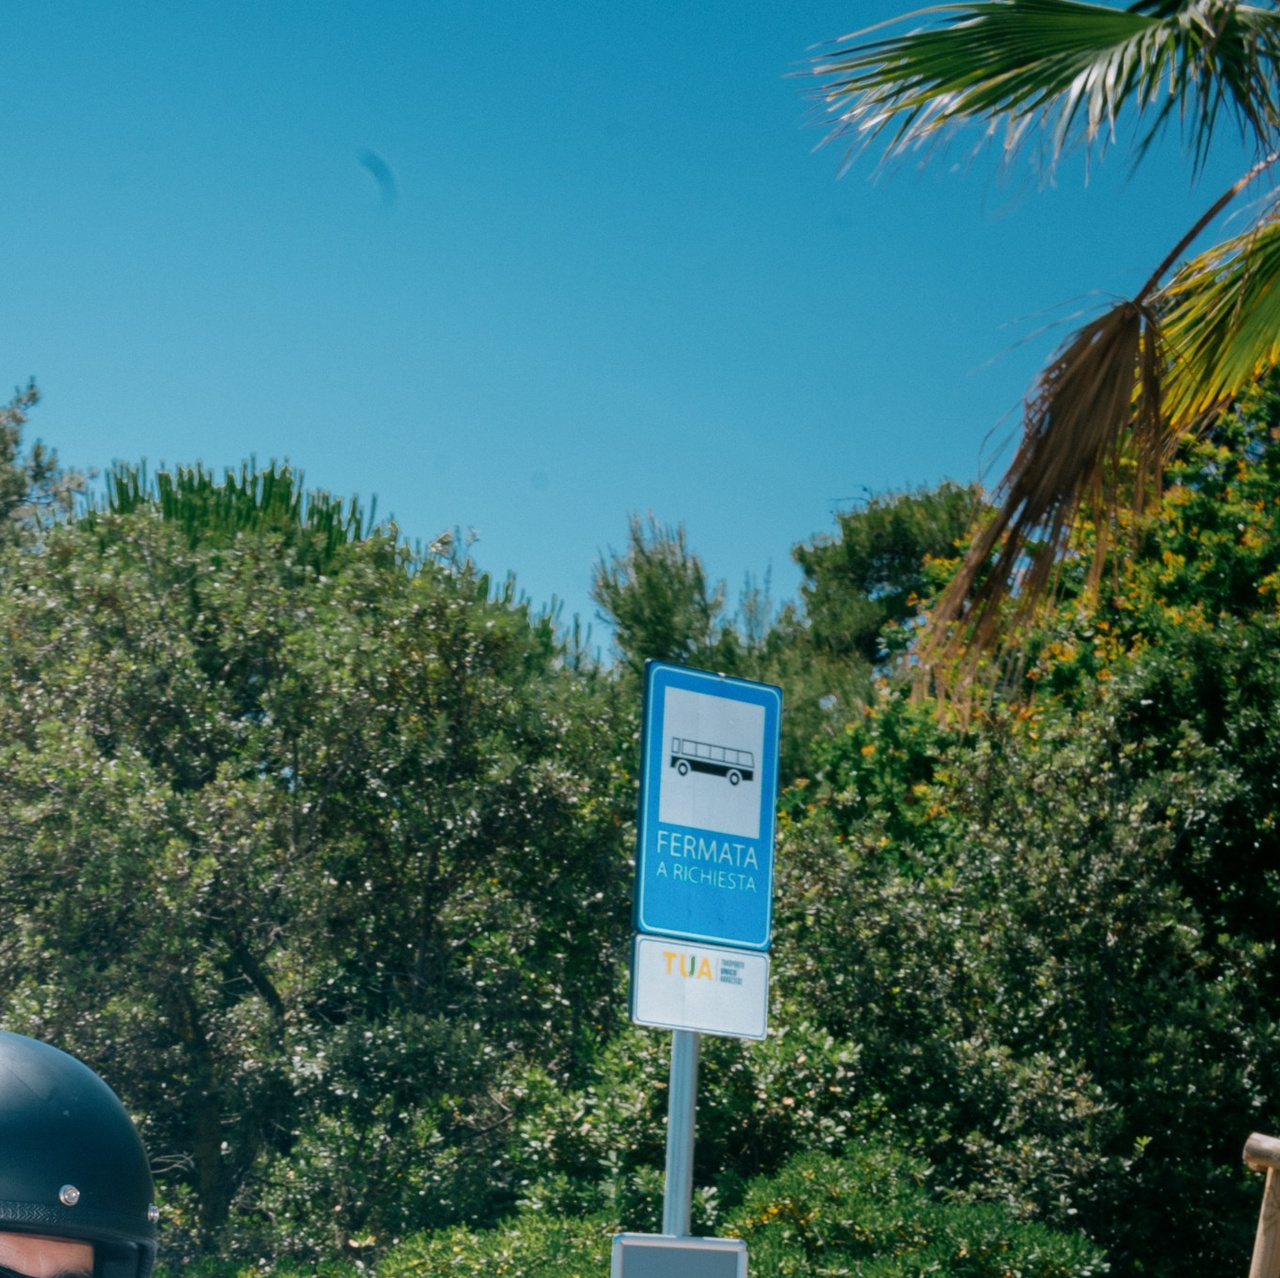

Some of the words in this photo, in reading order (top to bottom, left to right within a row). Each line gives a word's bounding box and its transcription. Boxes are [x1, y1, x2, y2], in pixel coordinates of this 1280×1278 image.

[657, 830, 758, 870] FERMATA
[656, 861, 668, 878] A
[673, 863, 756, 893] RICHIESTA
[662, 951, 713, 981] TUA
